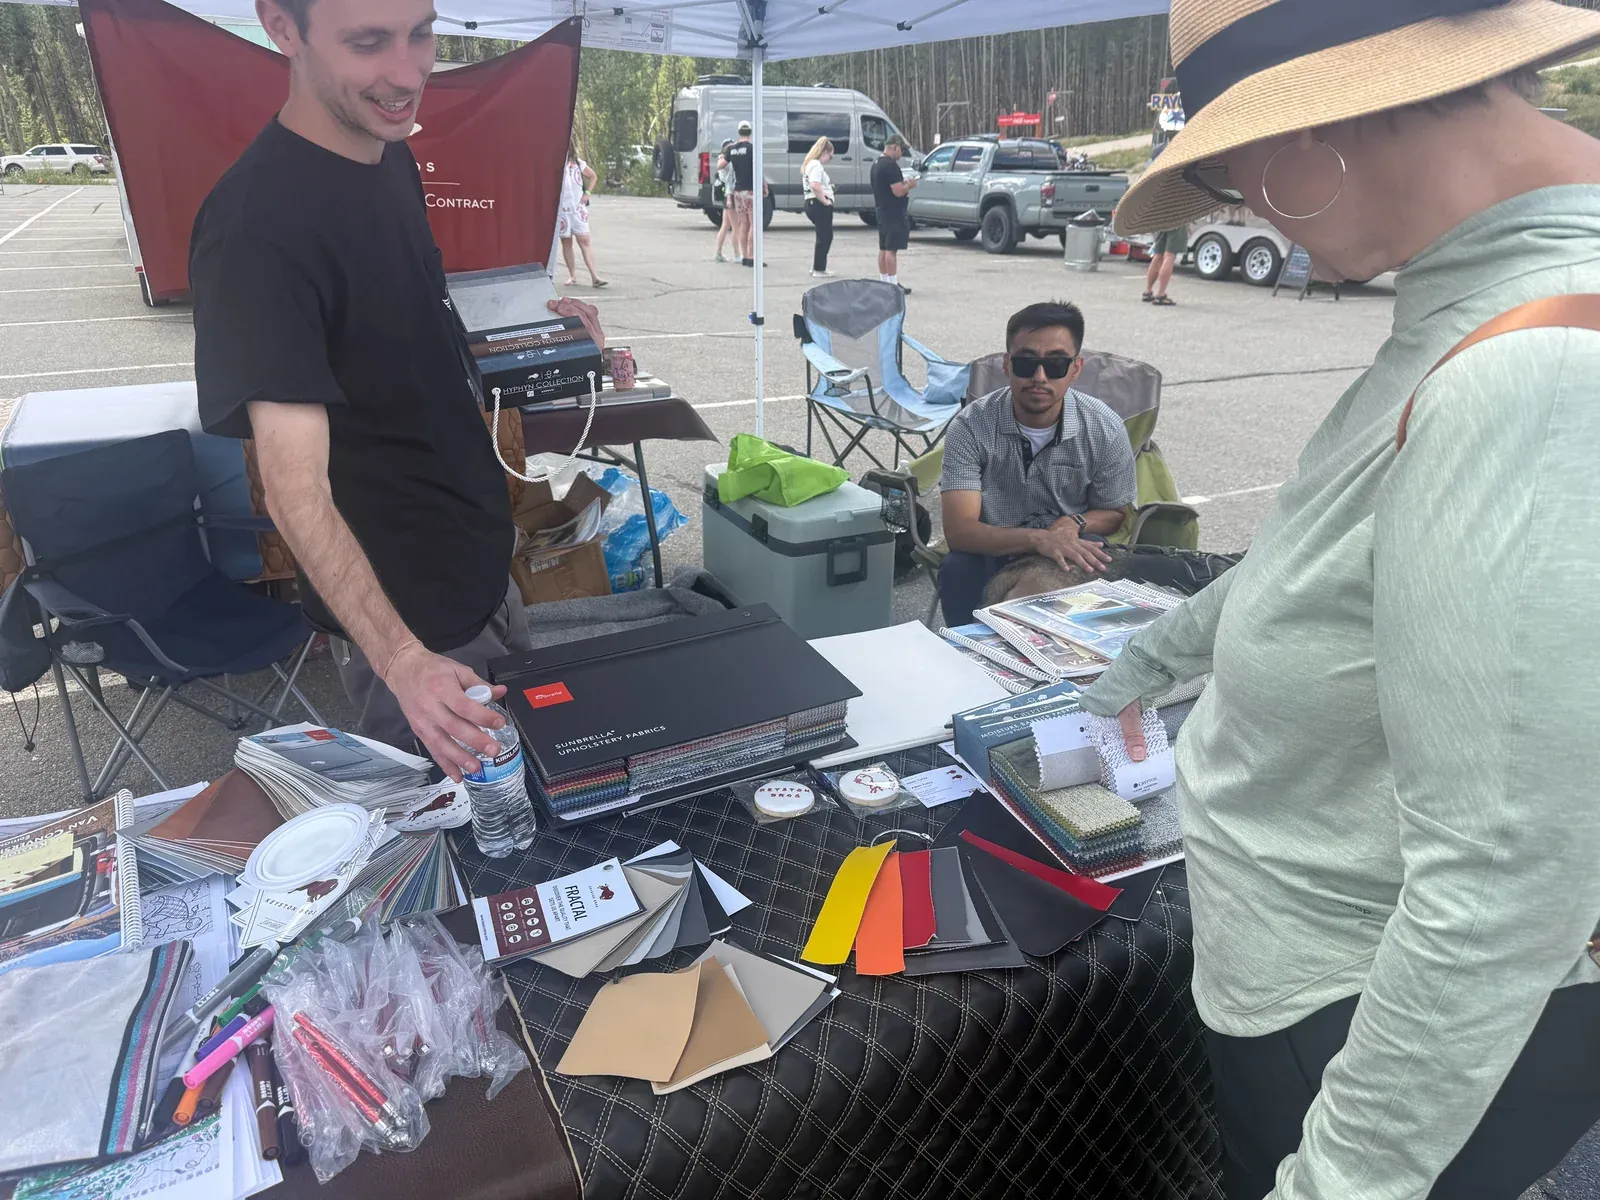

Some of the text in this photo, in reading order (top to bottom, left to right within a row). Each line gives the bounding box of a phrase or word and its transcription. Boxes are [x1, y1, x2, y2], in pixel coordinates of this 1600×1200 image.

[503, 384, 535, 396] HYPHYN
[535, 375, 584, 389] COLLECTION
[558, 725, 666, 756] UPHOLSTERY FABRICS
[981, 723, 1018, 738] MOISTURE
[69, 815, 98, 830] VAN
[551, 885, 562, 902] DISCOVER
[558, 907, 568, 923] QUALITY
[563, 921, 571, 932] THAT
[564, 883, 588, 922] FRACTAL
[552, 911, 561, 923] APART
